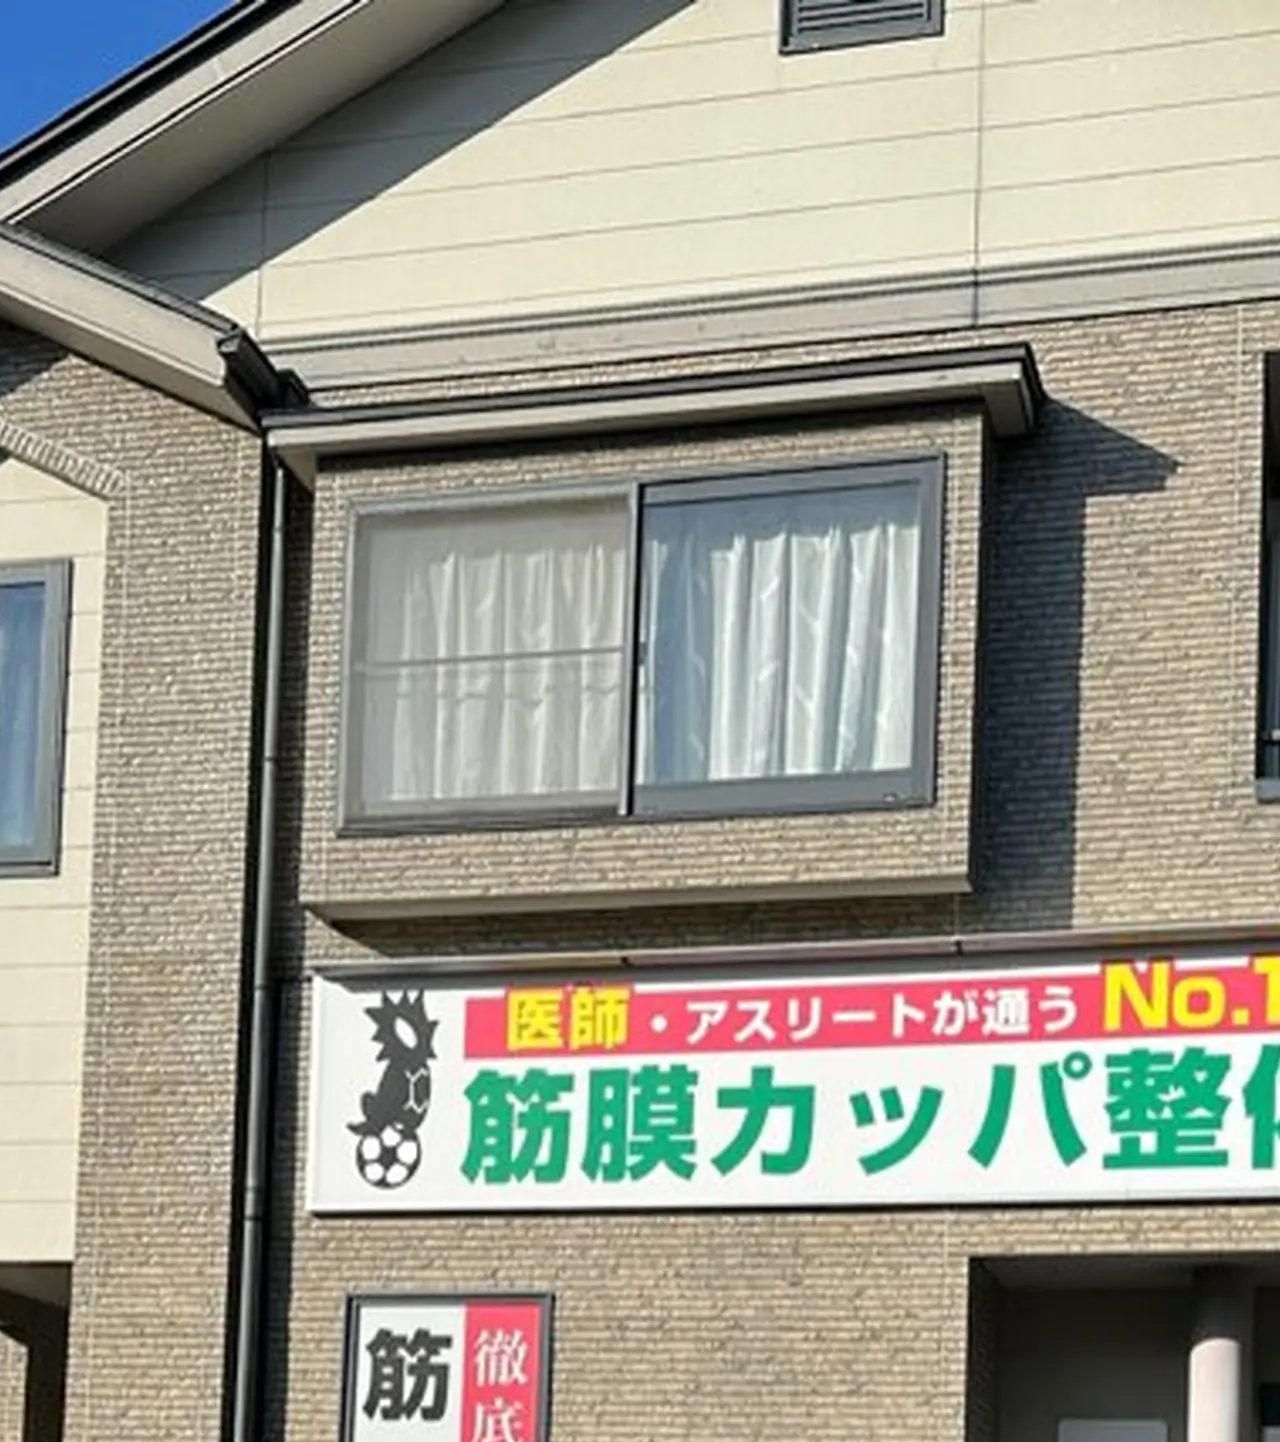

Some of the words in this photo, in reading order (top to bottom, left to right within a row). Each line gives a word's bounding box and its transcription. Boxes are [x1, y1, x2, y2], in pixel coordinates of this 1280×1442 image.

[505, 987, 1077, 1050] 医師・アスリートが通う
